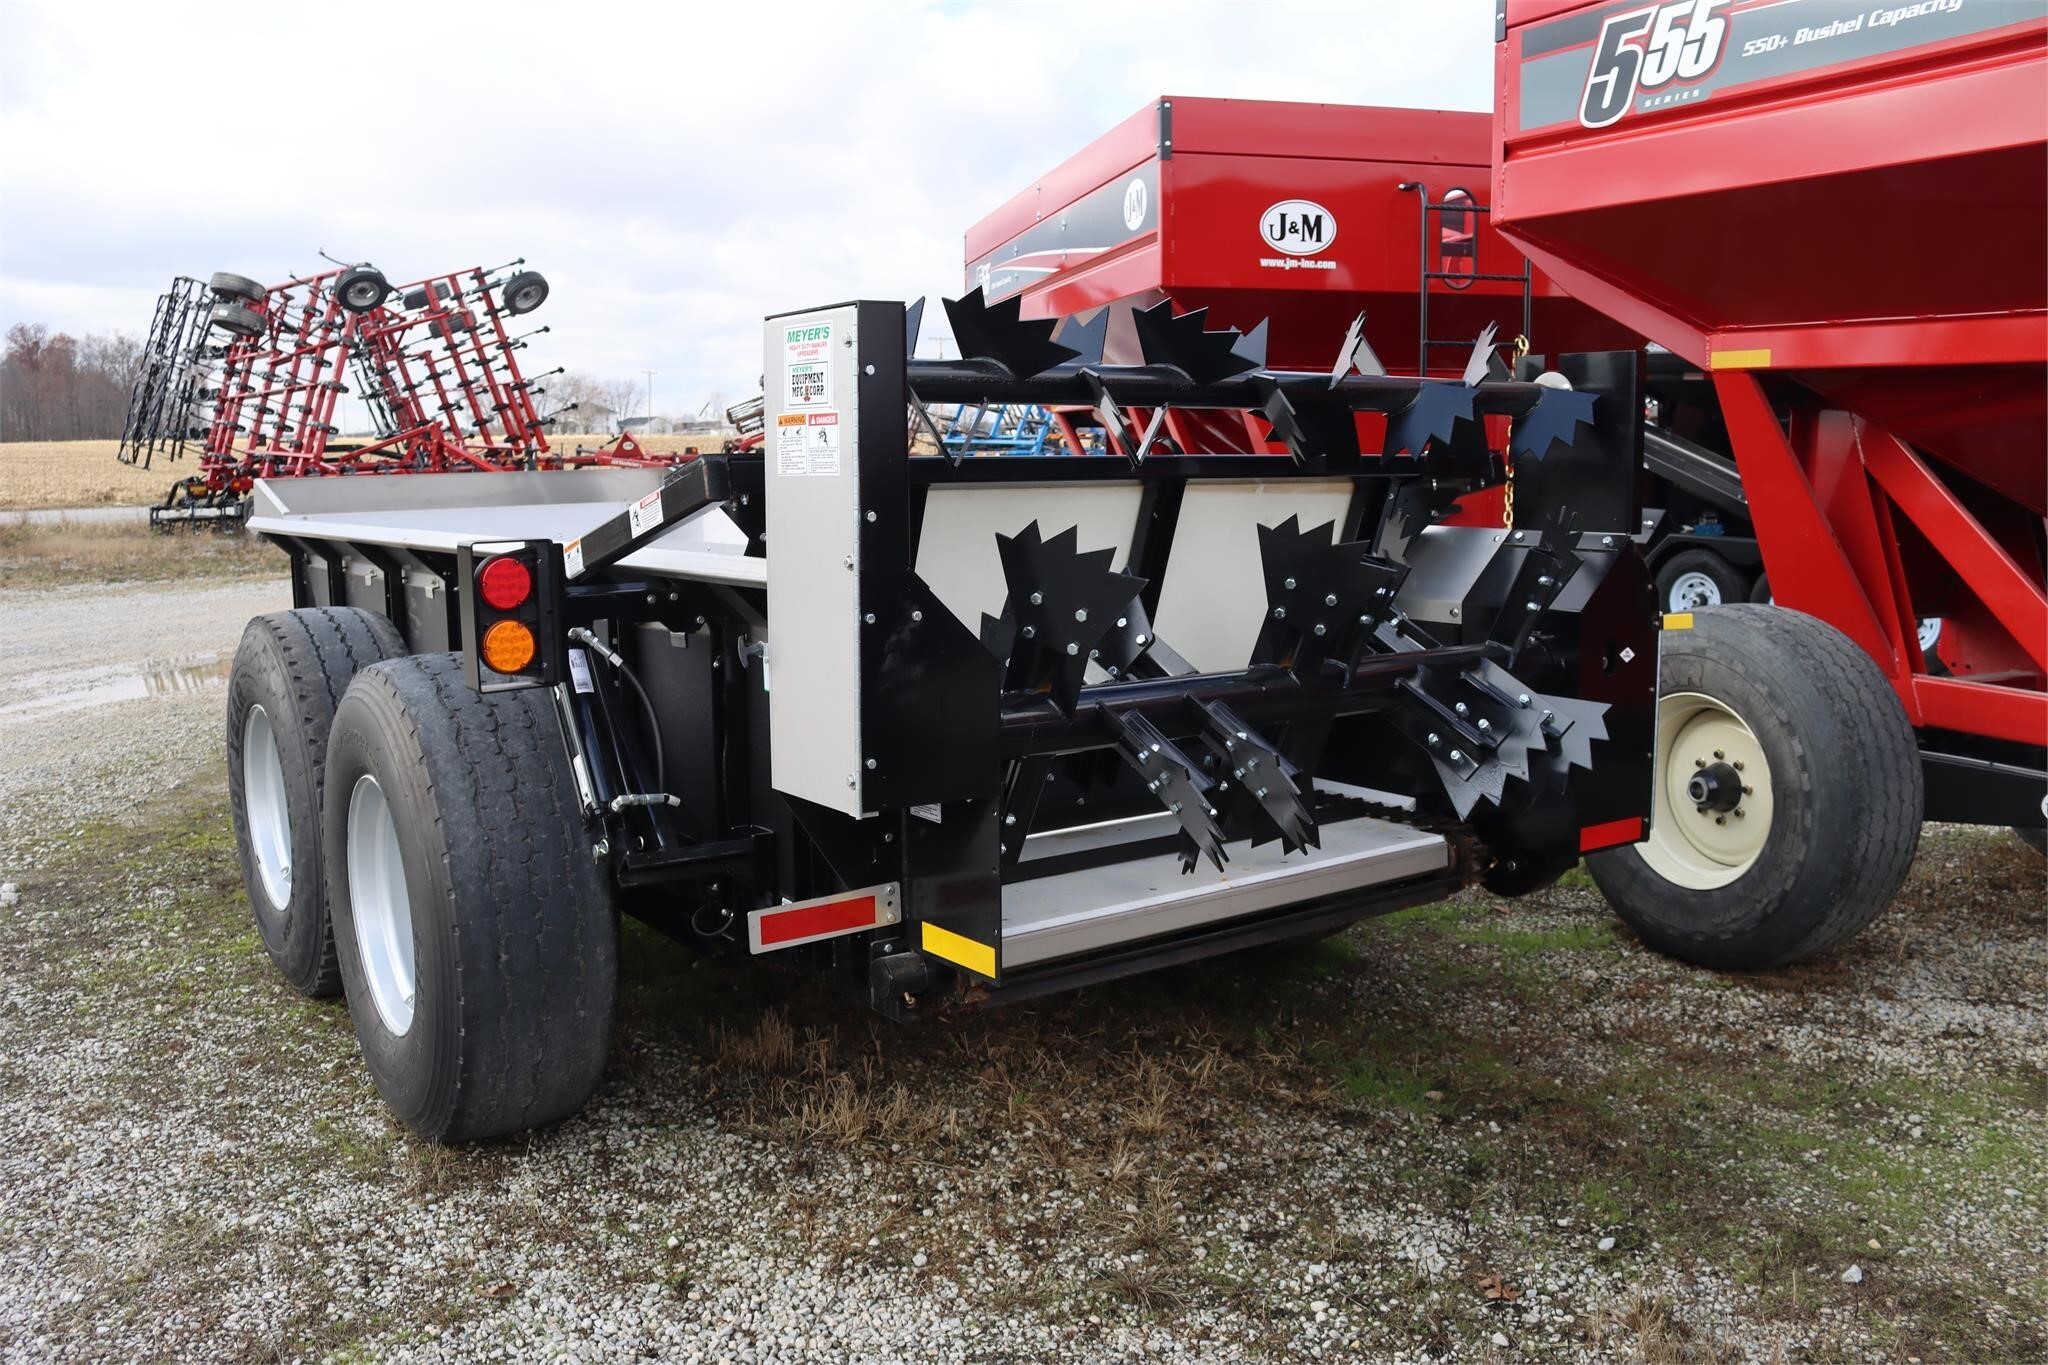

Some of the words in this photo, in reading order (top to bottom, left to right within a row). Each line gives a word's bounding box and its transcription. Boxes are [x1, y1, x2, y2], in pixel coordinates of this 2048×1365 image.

[1742, 34, 1788, 57] 550+
[1793, 13, 1865, 46] Bushel
[1867, 0, 1964, 28] Capacity
[1579, 0, 1727, 129] 555
[1644, 88, 1700, 108] SERIES
[1268, 212, 1324, 243] J&M
[1259, 257, 1337, 270] www.jm-inc.com
[787, 326, 830, 343] MEYER'S
[792, 365, 813, 374] MEYER'S
[791, 371, 824, 386] EQUIPMENT
[784, 415, 805, 425] WARNING
[816, 415, 836, 425] DANGER
